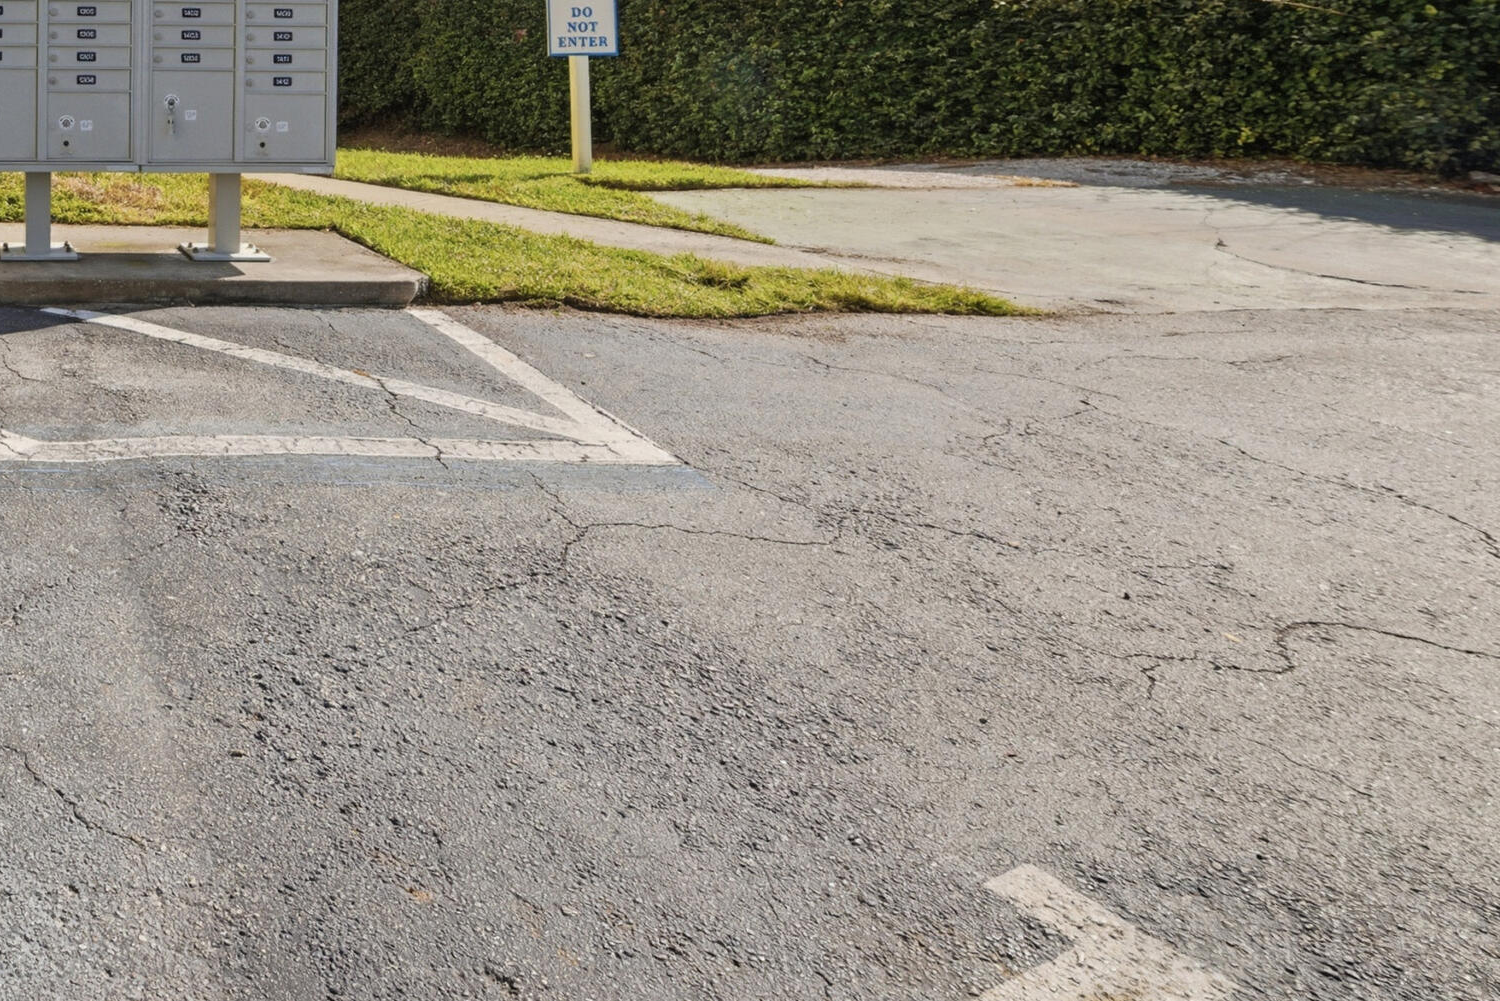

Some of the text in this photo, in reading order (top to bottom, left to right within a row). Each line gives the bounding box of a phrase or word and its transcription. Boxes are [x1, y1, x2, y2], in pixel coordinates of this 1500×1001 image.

[570, 6, 593, 18] DO
[567, 21, 598, 33] NOT
[557, 36, 608, 48] ENTER
